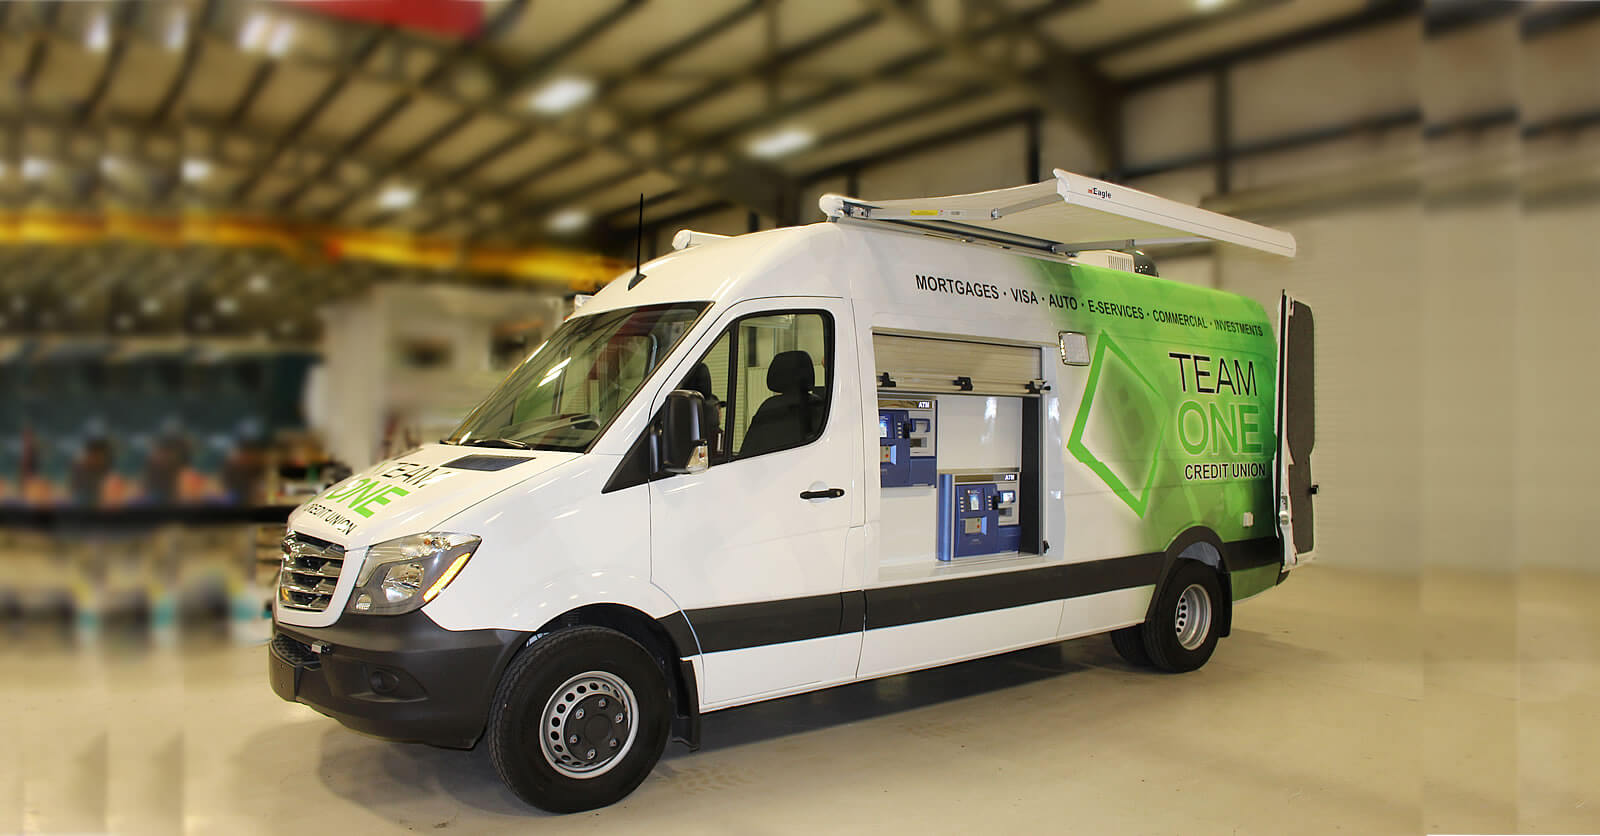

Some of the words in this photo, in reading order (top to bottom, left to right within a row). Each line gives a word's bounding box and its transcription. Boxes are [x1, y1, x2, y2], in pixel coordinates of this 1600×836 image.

[1093, 187, 1112, 199] Eagle
[915, 274, 1000, 300] MORTGAGES
[1010, 287, 1039, 305] VISA
[1049, 295, 1078, 311] AUTO
[1088, 300, 1145, 320] E-SERVICES
[1152, 310, 1208, 329] COMMERCIAL
[1213, 319, 1264, 337] INVESTMENTS
[1168, 352, 1257, 397] TEAM
[918, 401, 930, 409] ATM
[1177, 400, 1264, 457] ONE
[1184, 464, 1229, 480] CREDIT
[1231, 463, 1266, 478] UNION
[325, 478, 411, 519] ONE
[325, 511, 358, 536] UNION
